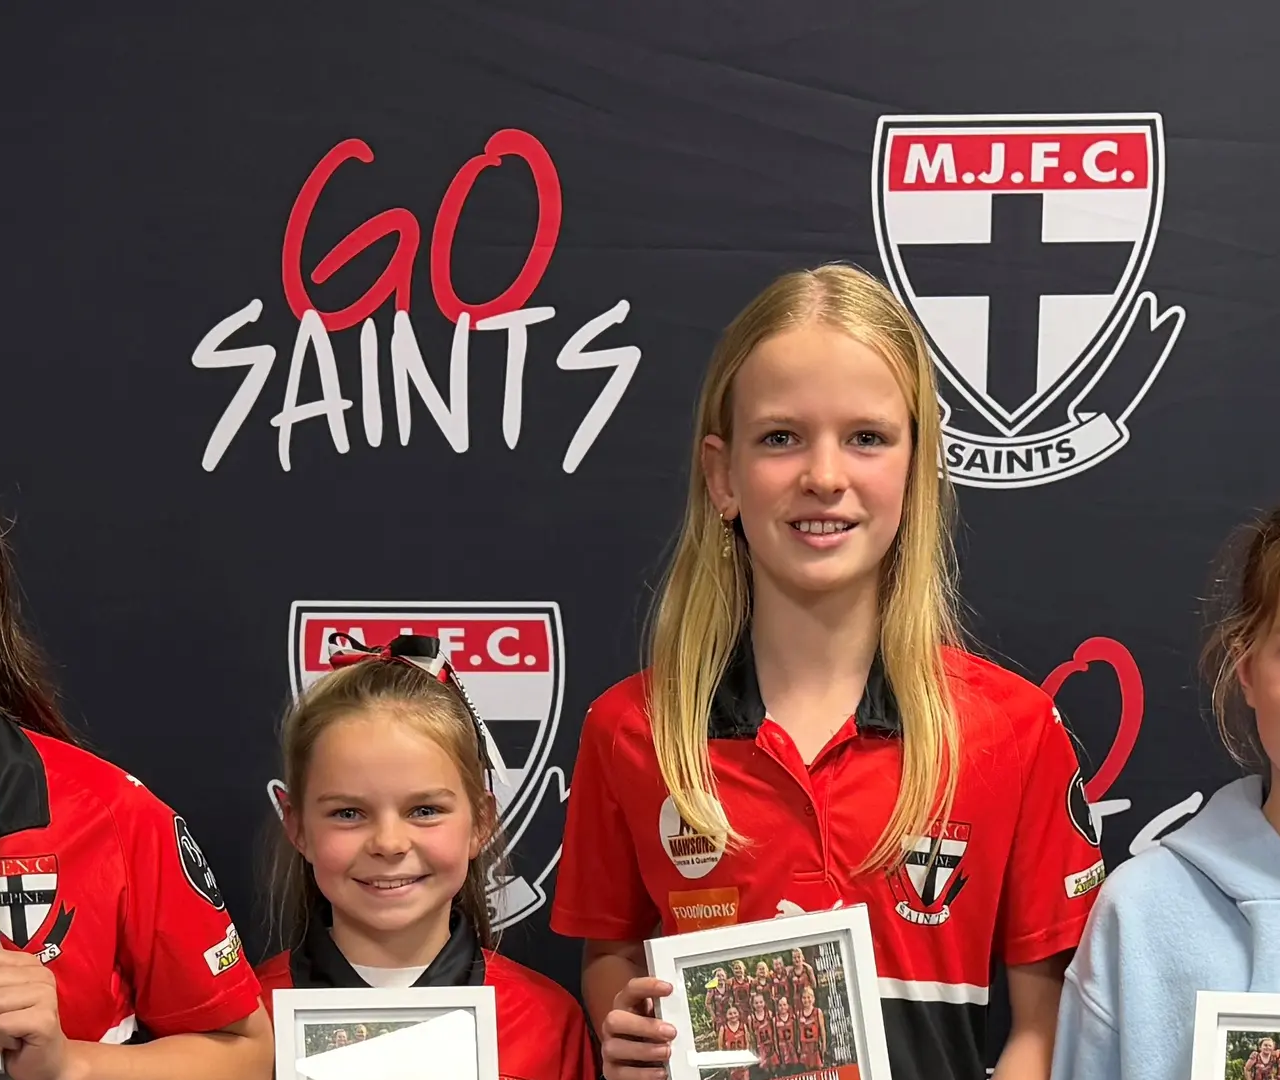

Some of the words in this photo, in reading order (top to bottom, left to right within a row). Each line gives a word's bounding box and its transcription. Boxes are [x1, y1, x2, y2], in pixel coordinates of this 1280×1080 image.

[902, 140, 1135, 184] M.J.F.C.
[281, 128, 562, 331] GO
[192, 299, 641, 473] SAINTS
[946, 437, 1077, 474] SAINTS
